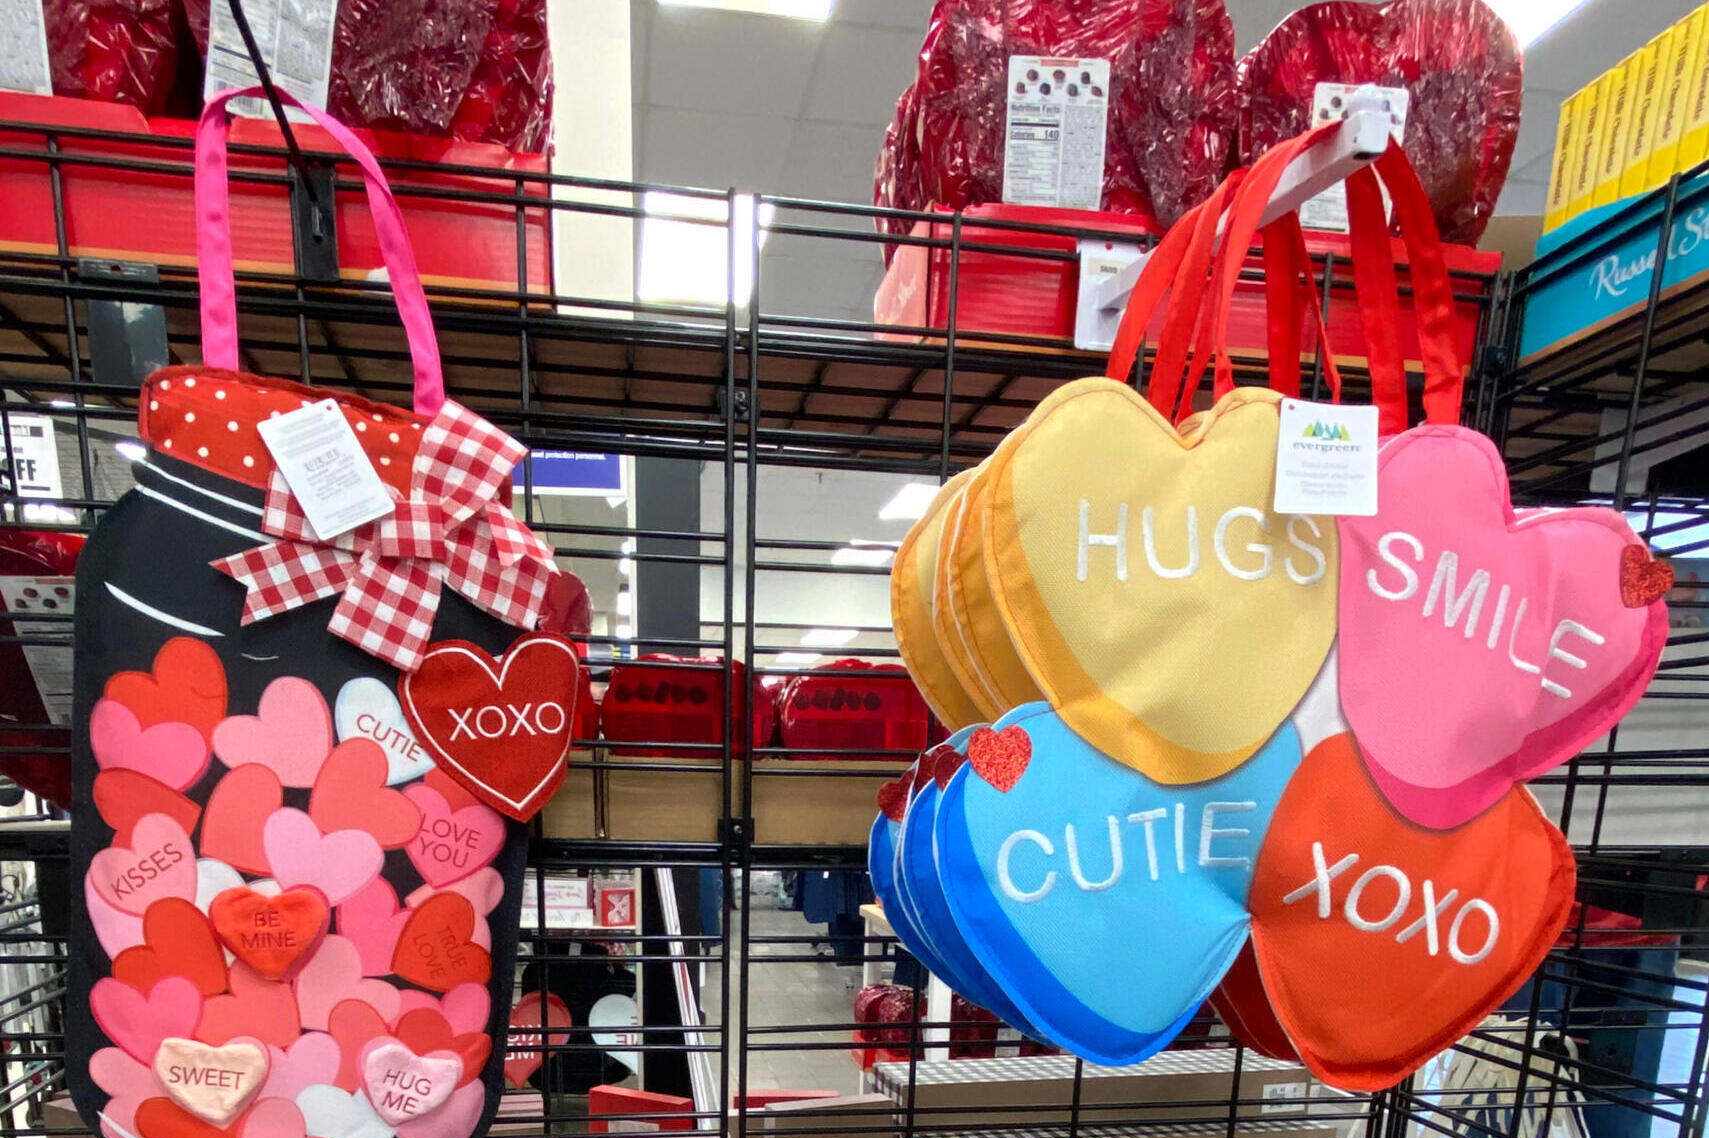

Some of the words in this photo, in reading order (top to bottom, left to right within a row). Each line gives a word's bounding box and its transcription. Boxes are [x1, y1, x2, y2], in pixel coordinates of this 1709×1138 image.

[1292, 441, 1362, 453] evergreen
[1076, 499, 1327, 584] HUGS
[1367, 531, 1605, 699] SMILE
[356, 714, 422, 762] CUTIE
[447, 702, 566, 742] XOXO
[420, 813, 482, 850] LOVE
[110, 842, 184, 901] KISSES
[419, 837, 470, 869] YOU
[996, 801, 1257, 903] CUTIE
[254, 911, 281, 928] BE
[1283, 841, 1501, 966] XOXO
[240, 930, 297, 949] MINE
[413, 933, 448, 980] LOVE
[437, 925, 468, 970] TRUE
[169, 1065, 246, 1090] SWEET
[382, 1068, 432, 1097] HUG
[381, 1093, 420, 1116] ME
